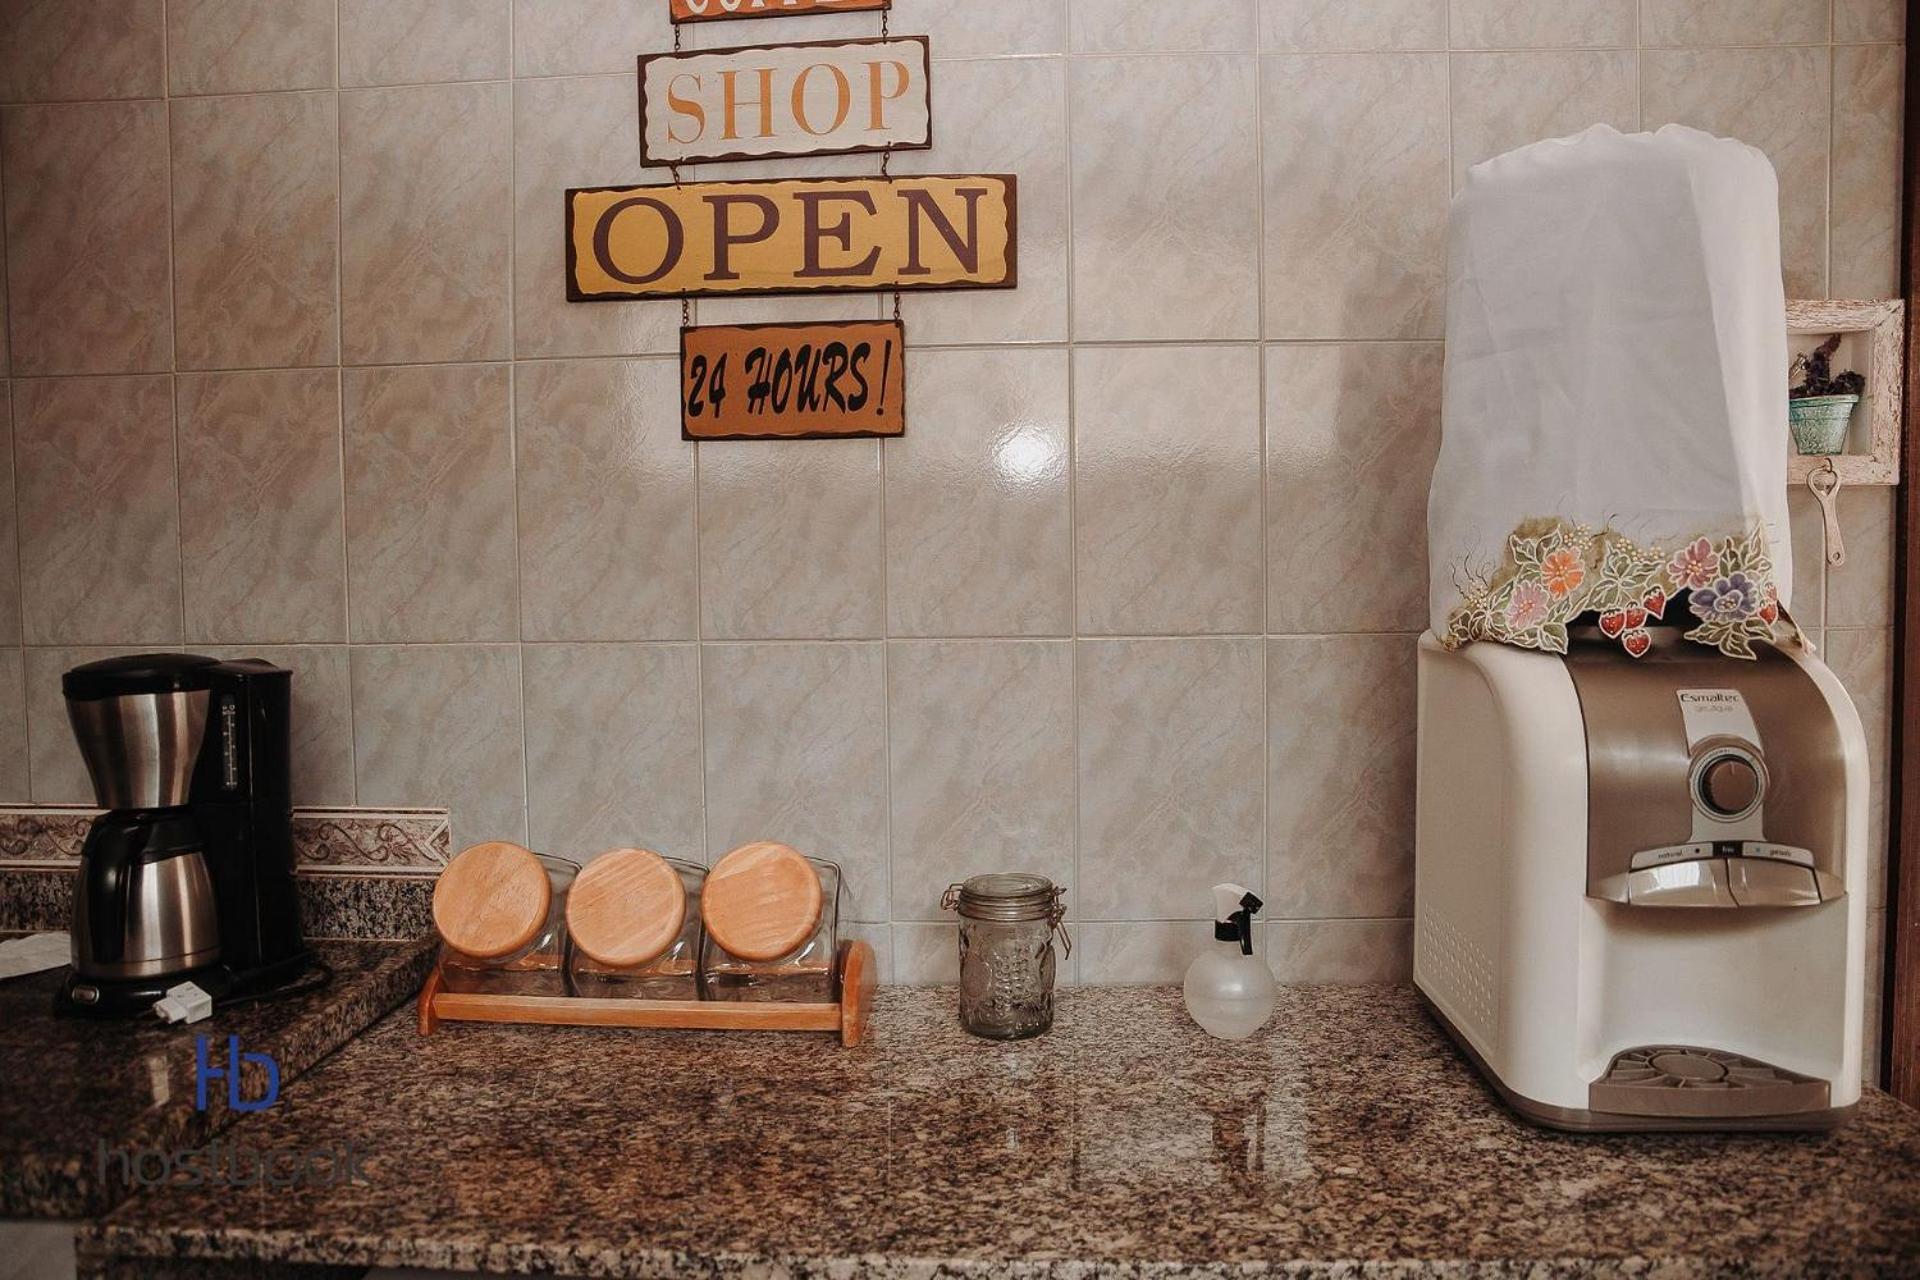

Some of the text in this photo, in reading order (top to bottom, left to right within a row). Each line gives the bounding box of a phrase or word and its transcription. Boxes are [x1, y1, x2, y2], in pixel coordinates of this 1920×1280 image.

[667, 60, 910, 144] SHOP
[592, 188, 988, 285] OPEN
[688, 339, 892, 418] 24 HOURS!
